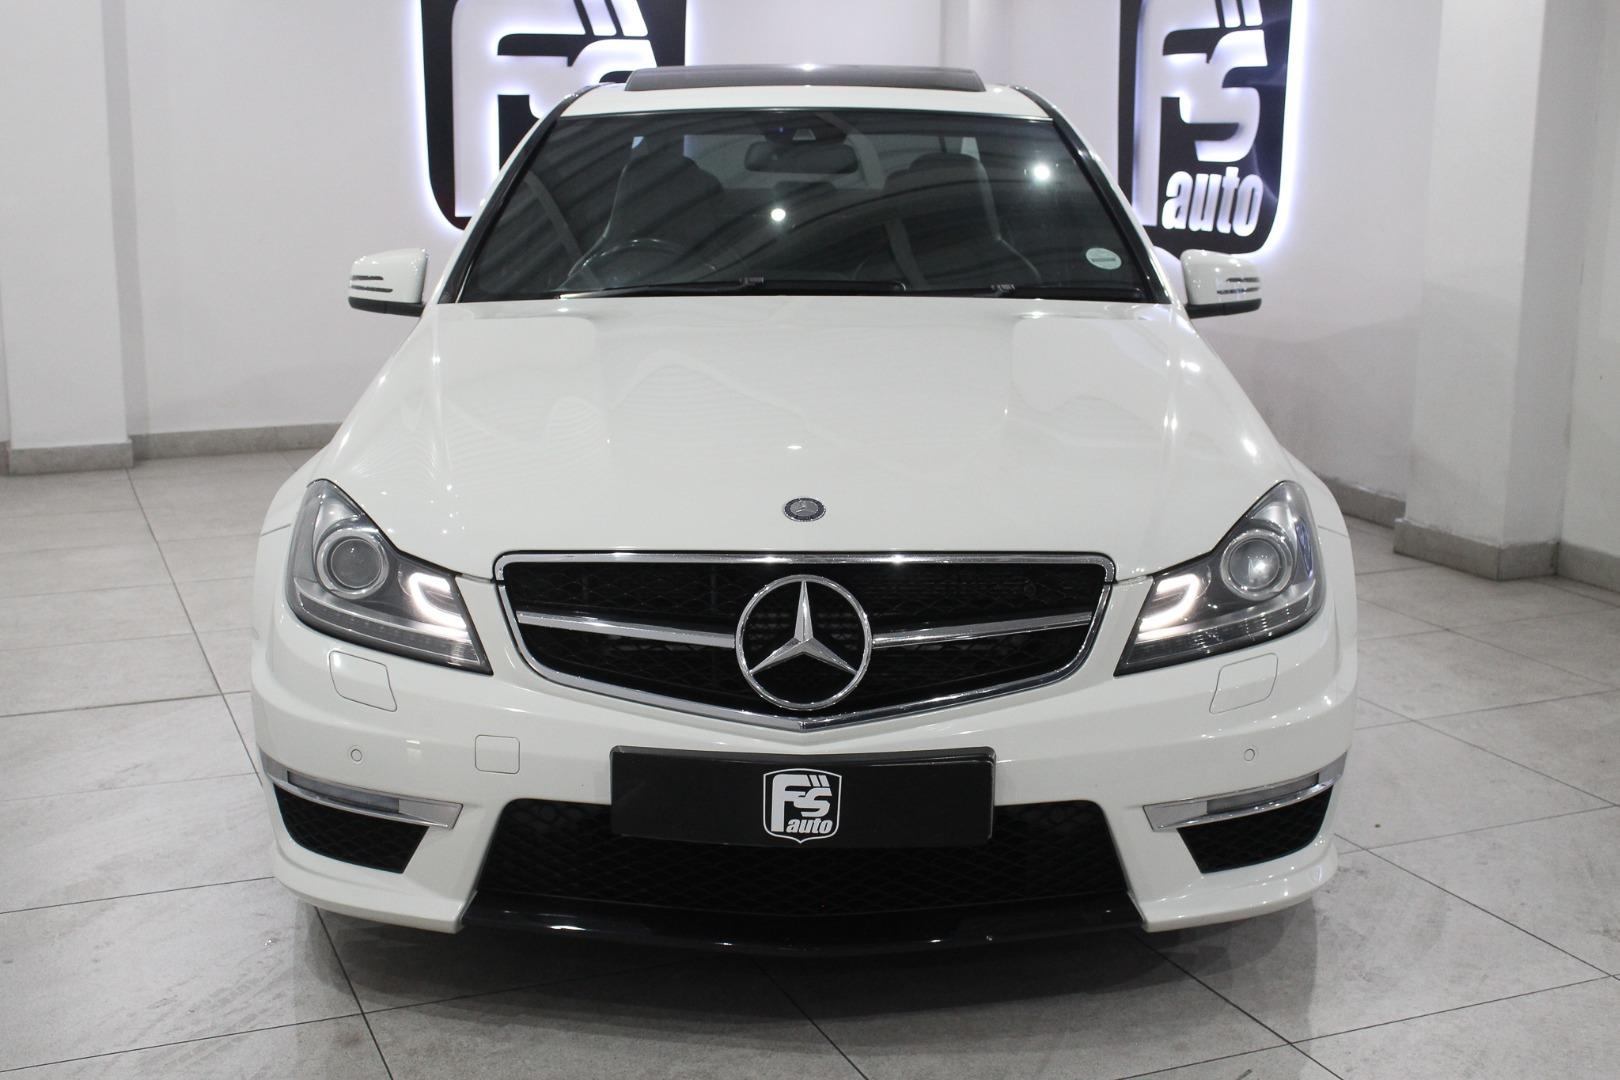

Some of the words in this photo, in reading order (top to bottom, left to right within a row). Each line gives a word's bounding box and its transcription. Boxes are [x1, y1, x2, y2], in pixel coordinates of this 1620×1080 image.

[1132, 0, 1268, 226] FS
[1162, 166, 1264, 237] auto
[771, 773, 832, 832] FS
[786, 818, 833, 834] auto
